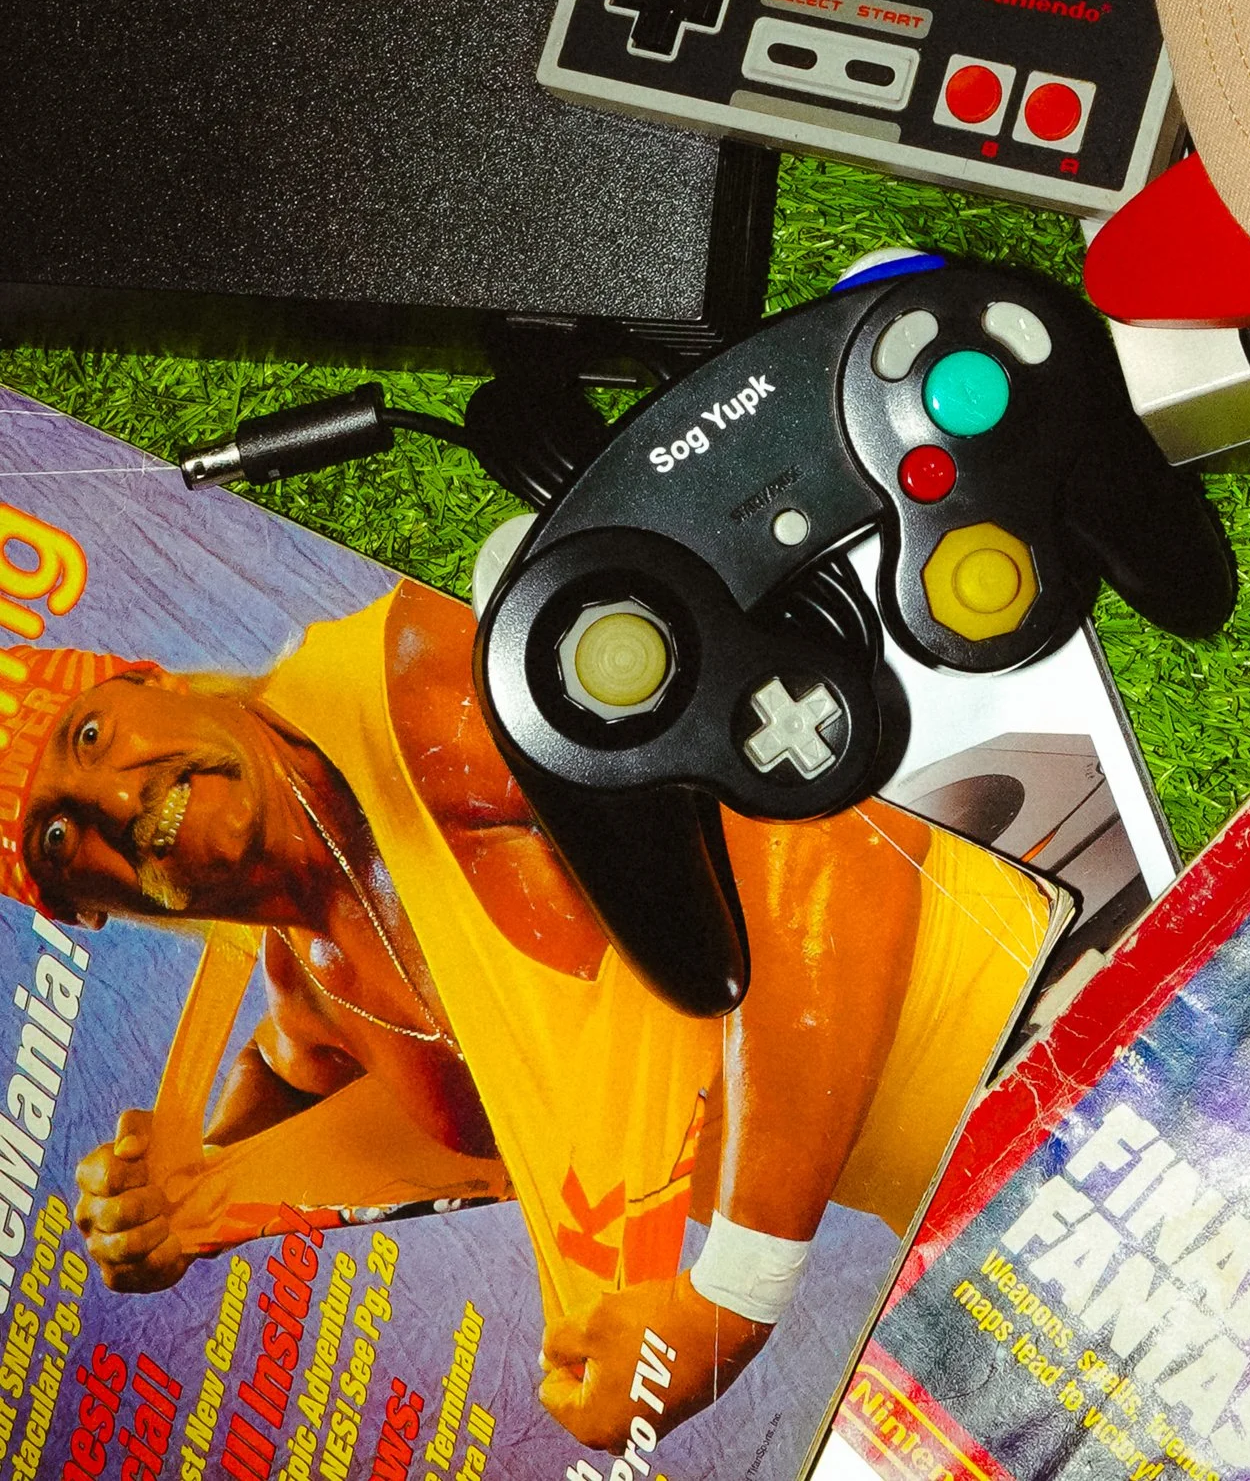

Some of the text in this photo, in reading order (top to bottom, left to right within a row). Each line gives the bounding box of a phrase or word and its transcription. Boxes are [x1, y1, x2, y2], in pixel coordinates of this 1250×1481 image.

[855, 3, 926, 31] START
[648, 373, 777, 474] Sog Yupk
[0, 1193, 72, 1399] SNES ProTip
[59, 1249, 89, 1298] 10
[237, 1201, 329, 1416] Inside!
[296, 1250, 358, 1426] Adventure
[339, 1230, 400, 1408] See 28
[952, 1278, 1086, 1413] maps lead to
[979, 1248, 1075, 1355] Weapons,
[185, 1254, 253, 1452] New Games
[424, 1299, 487, 1472] Terminator
[628, 1327, 678, 1416] TV!
